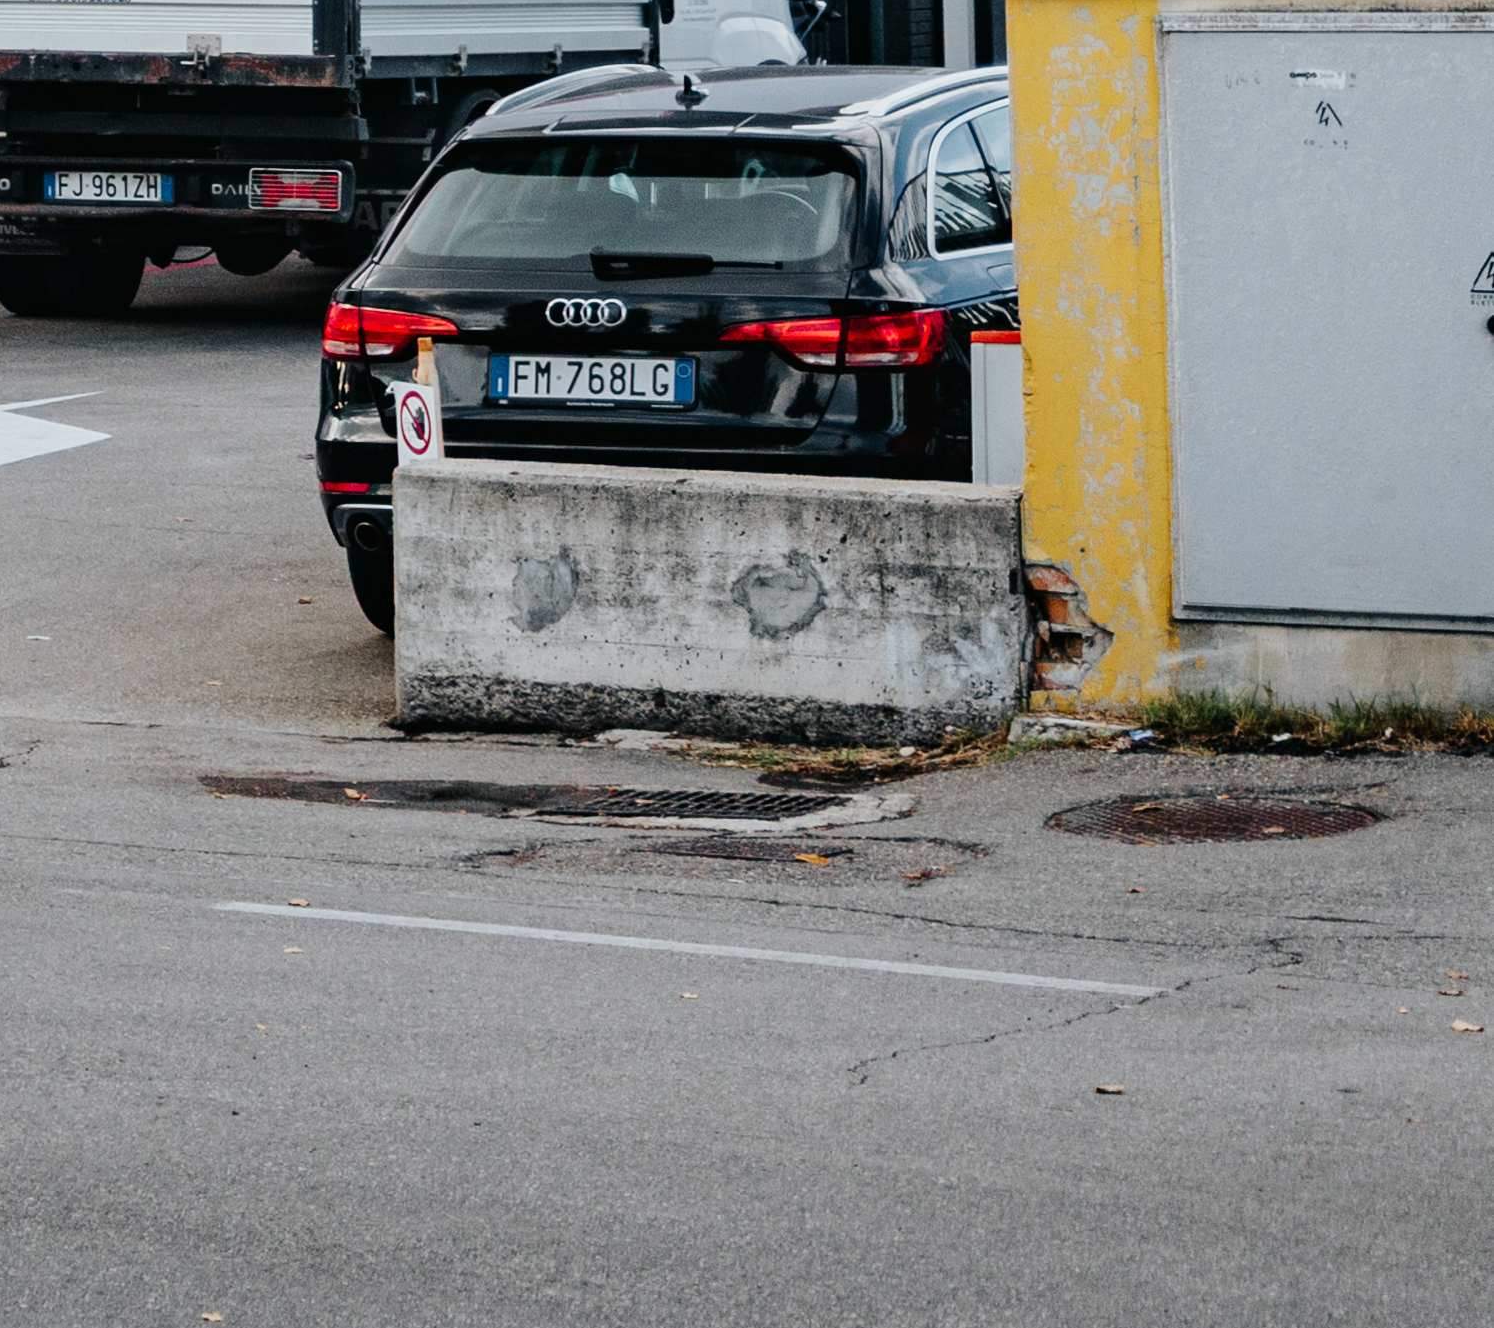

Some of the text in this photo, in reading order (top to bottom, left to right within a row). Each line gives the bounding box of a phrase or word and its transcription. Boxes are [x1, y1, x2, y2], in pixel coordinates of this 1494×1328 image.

[59, 174, 84, 198] FJ
[92, 175, 159, 199] 961ZH
[514, 360, 551, 394] FM
[566, 361, 669, 396] 768LG
